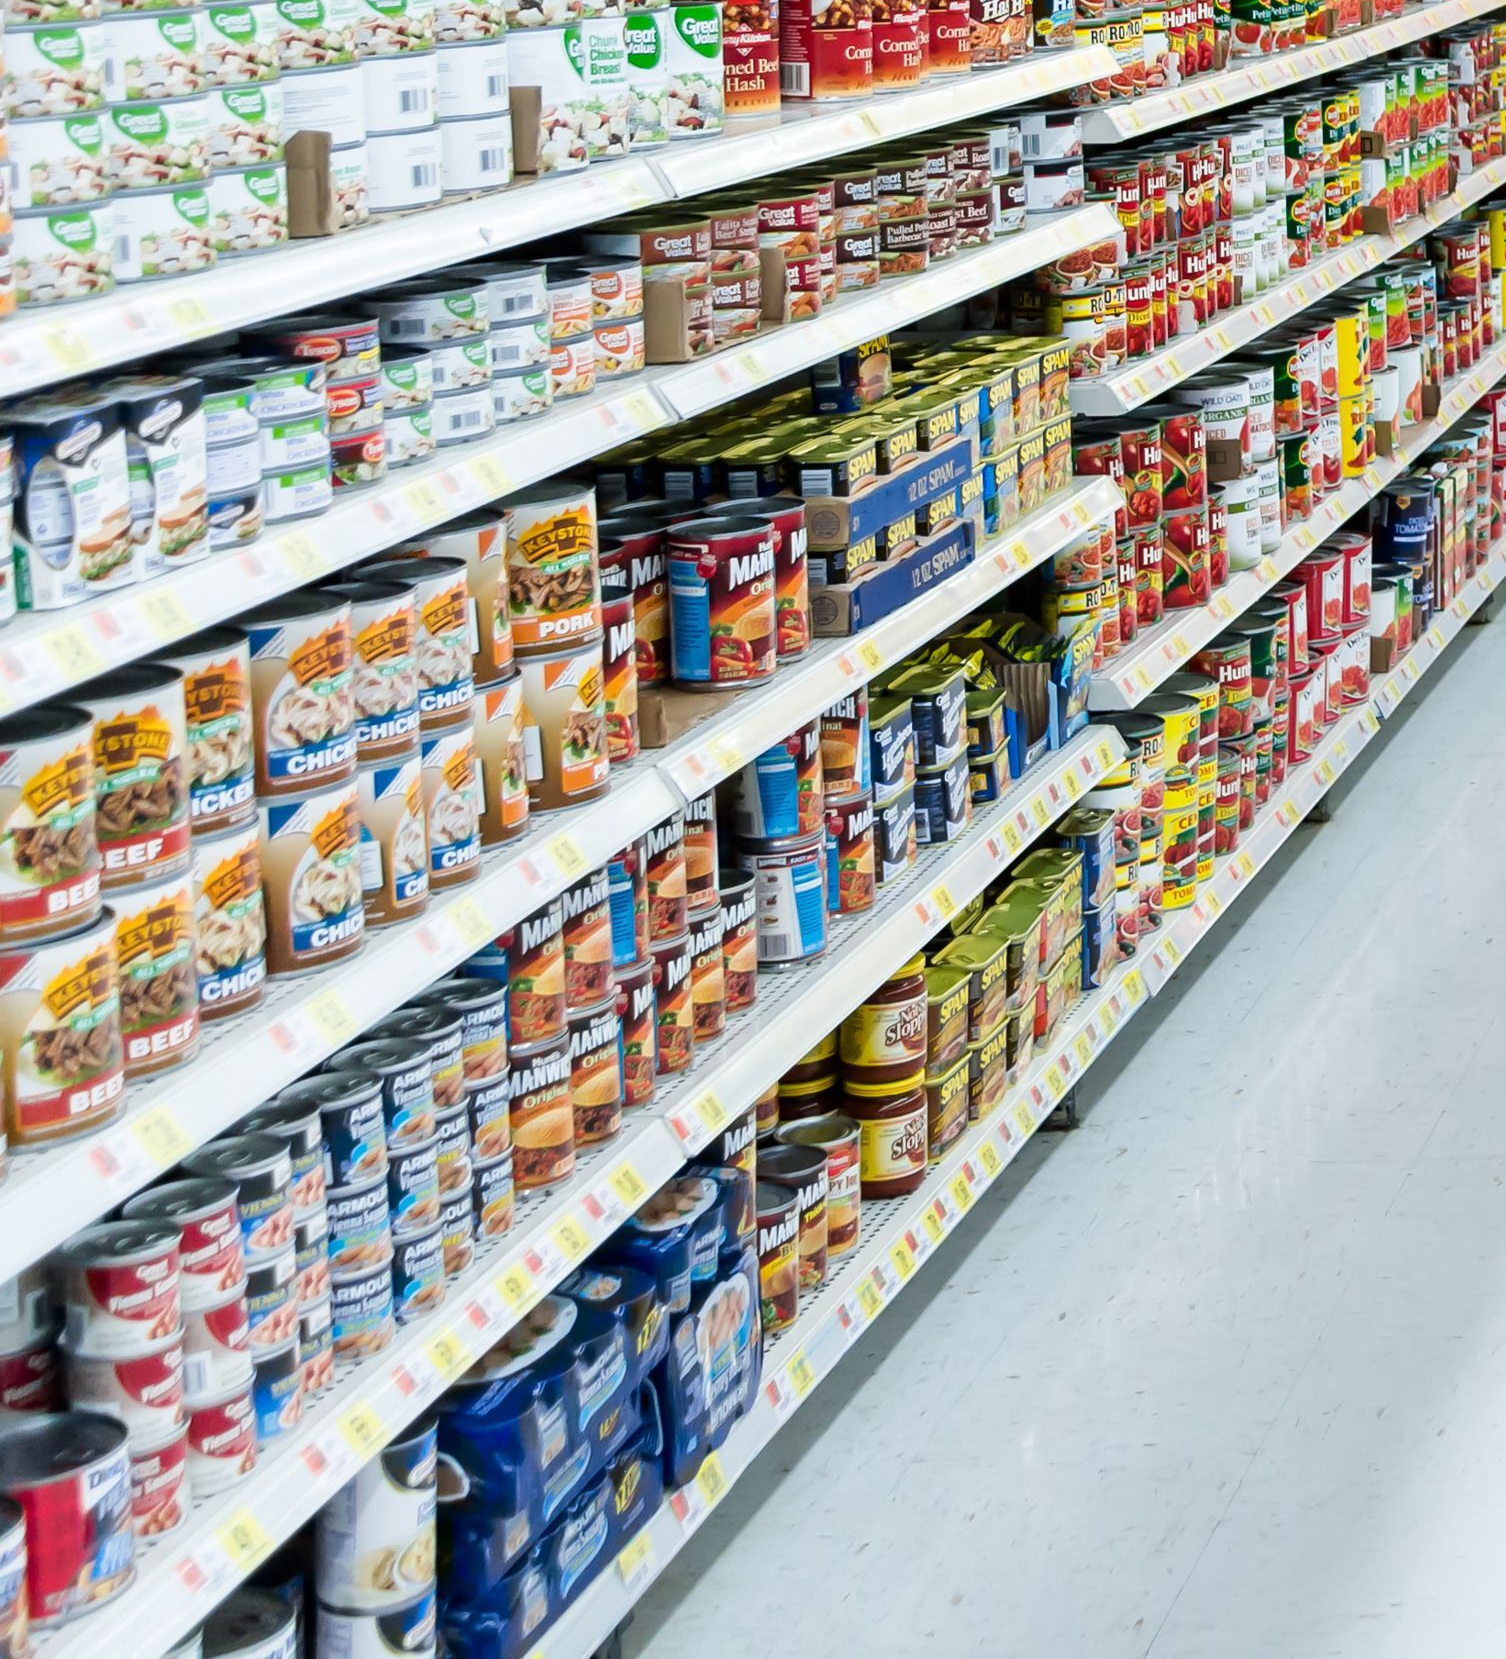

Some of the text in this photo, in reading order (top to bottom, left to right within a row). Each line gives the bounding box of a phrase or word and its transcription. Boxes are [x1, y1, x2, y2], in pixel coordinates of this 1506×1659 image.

[624, 28, 656, 43] reat
[682, 18, 718, 35] Great
[693, 32, 718, 45] Value
[726, 75, 765, 93] Hash
[118, 112, 161, 129] Great
[845, 182, 872, 195] Great
[759, 206, 795, 221] Great
[768, 215, 795, 228] Value
[968, 204, 988, 218] Beef
[654, 234, 692, 252] Great
[664, 246, 694, 259] Value
[845, 238, 872, 251] Great
[1043, 348, 1069, 374] SPAM
[1017, 364, 1040, 388] SPAM
[989, 378, 1012, 407] SPAM
[929, 409, 956, 438] SPAM
[959, 397, 979, 424] SPAM
[890, 429, 917, 459] SPAM
[1046, 420, 1071, 447] SPAM
[1020, 435, 1043, 465] SPAM
[849, 448, 876, 481] SPAM
[929, 460, 955, 491] SPAM
[995, 456, 1018, 485] SPAM
[961, 474, 982, 504] SPAM
[929, 493, 956, 524] SPAM
[888, 515, 915, 547] SPAM
[847, 537, 875, 571] SPAM
[932, 543, 959, 575] SPAM
[539, 610, 594, 638] PORK
[981, 955, 1007, 990] SPAM
[940, 989, 969, 1024] SPAM
[129, 1018, 195, 1058] BEEF
[980, 1031, 1007, 1069] SPAM
[941, 1067, 969, 1105] SPAM
